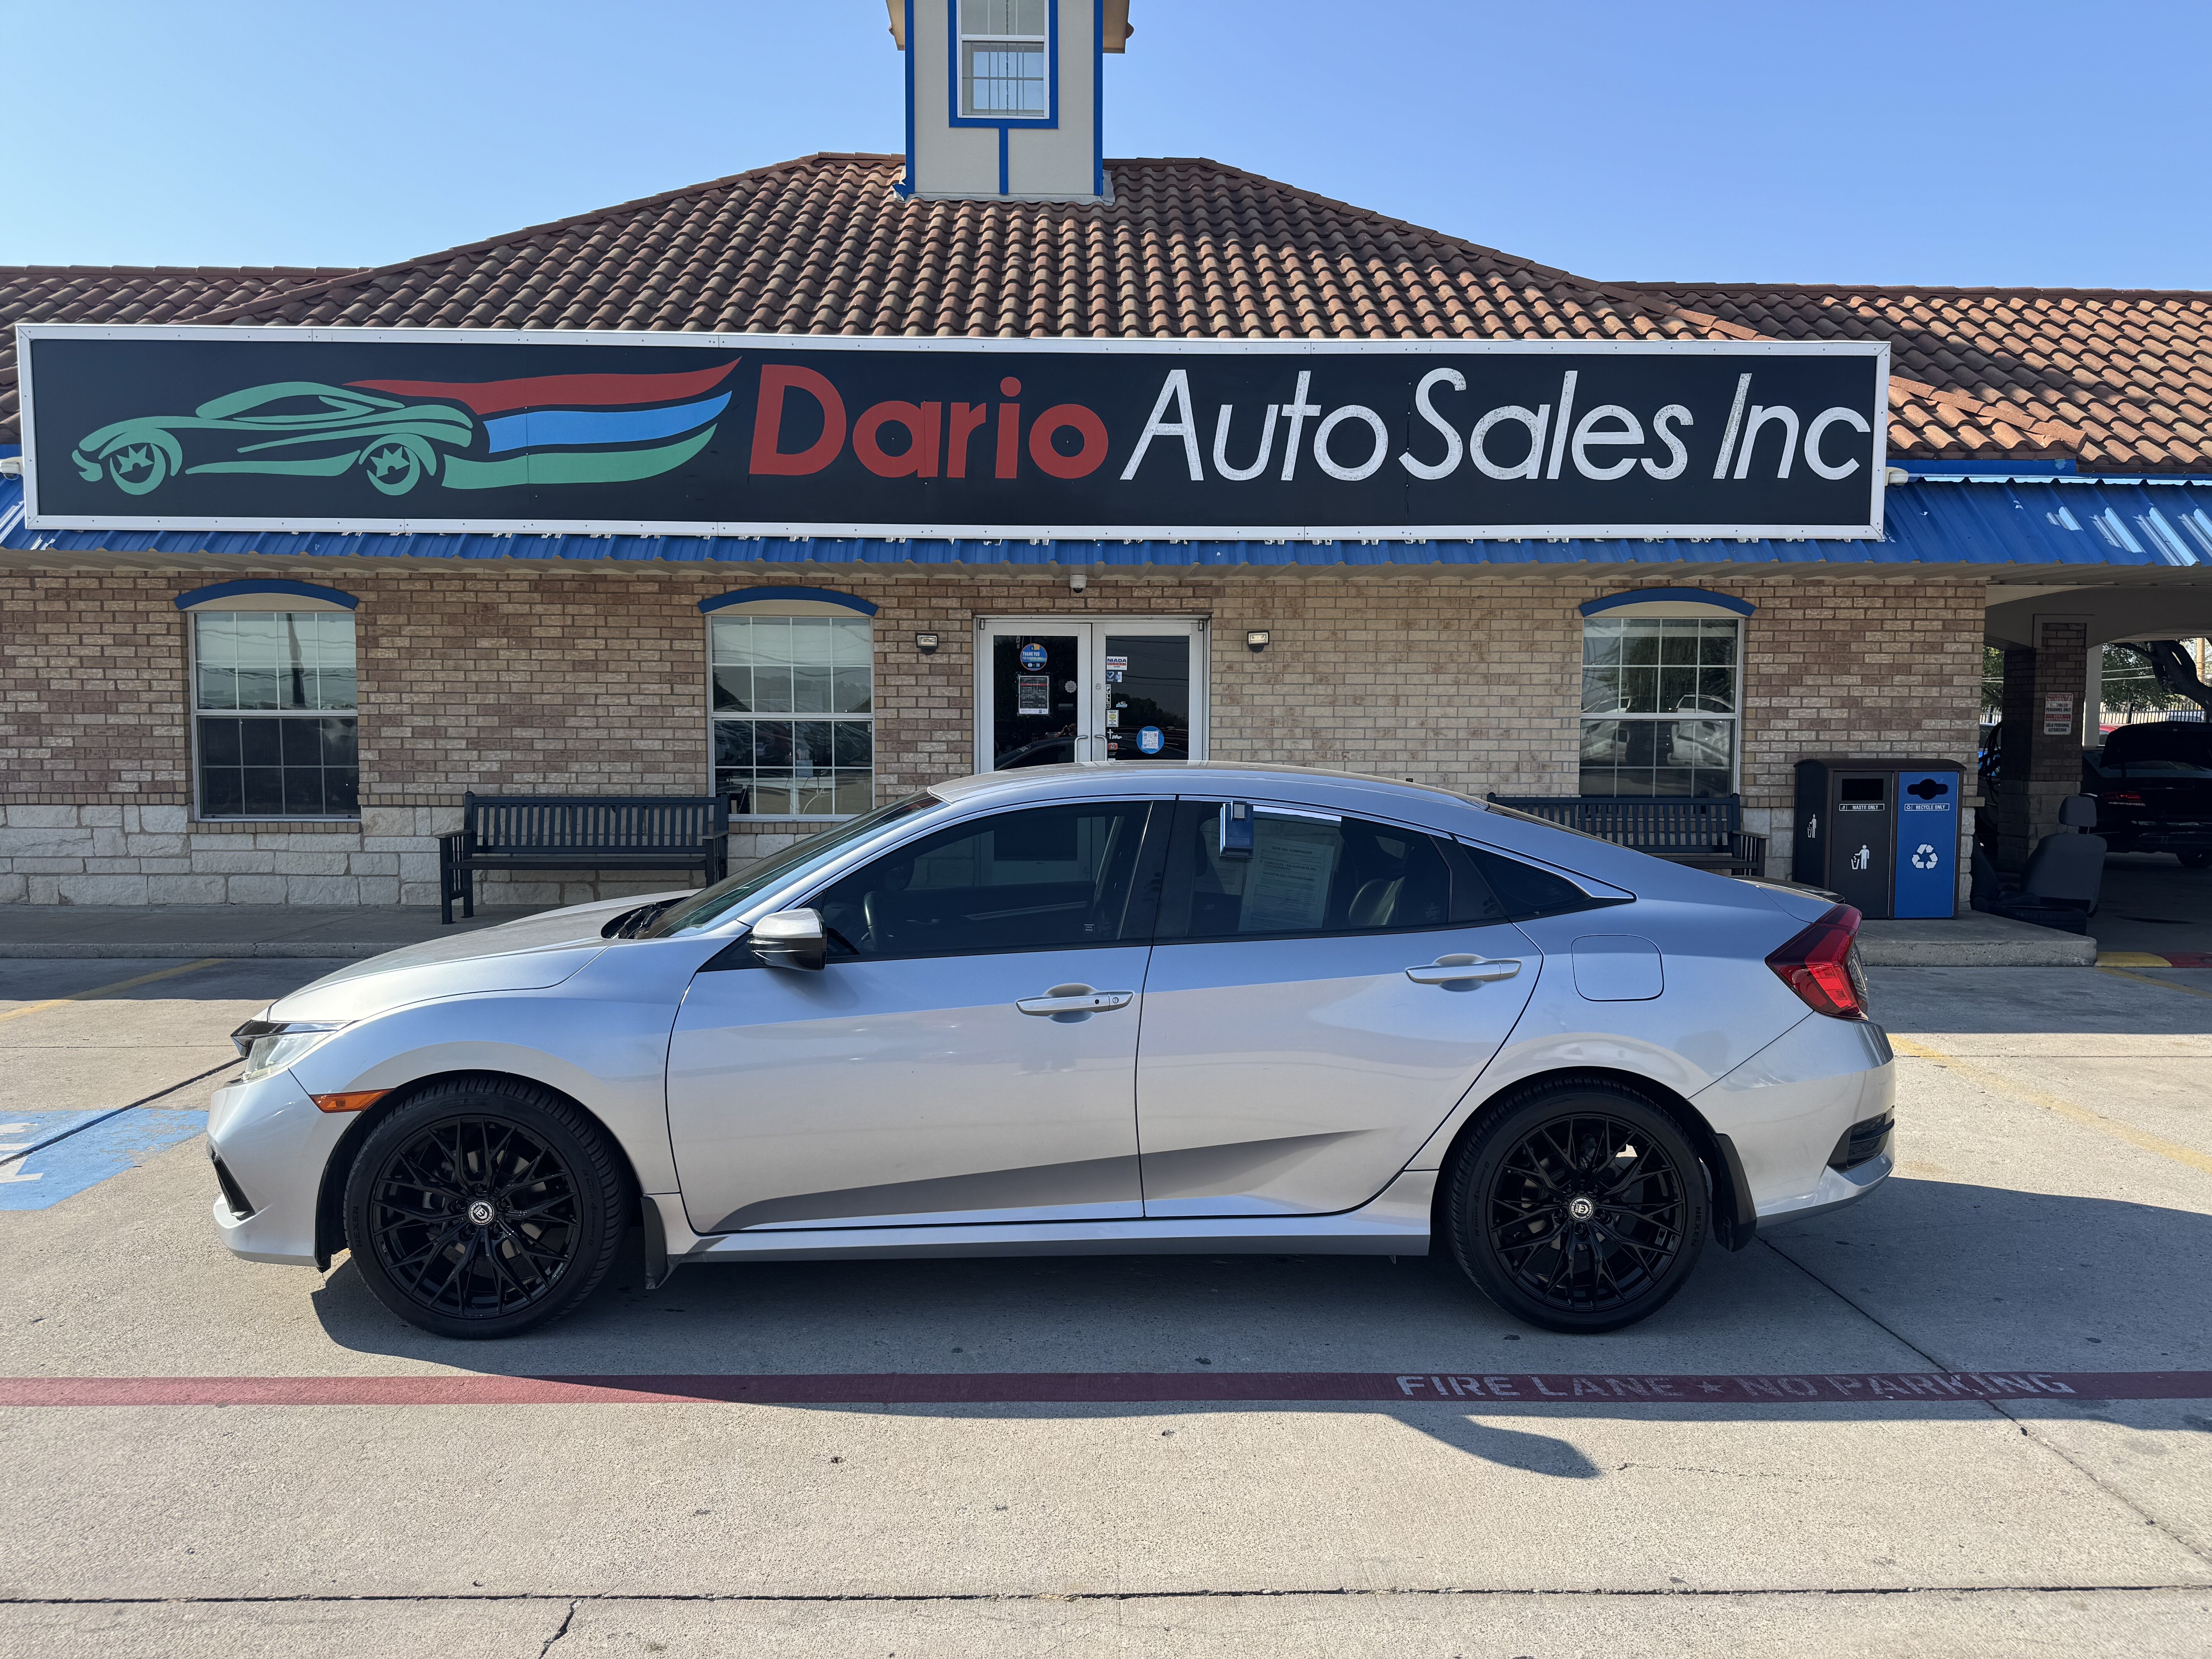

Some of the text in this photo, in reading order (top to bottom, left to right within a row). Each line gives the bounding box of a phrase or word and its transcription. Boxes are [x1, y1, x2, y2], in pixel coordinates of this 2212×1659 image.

[749, 364, 1871, 481] Dario Auto Sales Inc
[353, 1206, 363, 1247] NEXEN
[1691, 1206, 1701, 1246] NEXEN
[1396, 1373, 2076, 1396] FIRE LANE NO PARKING
